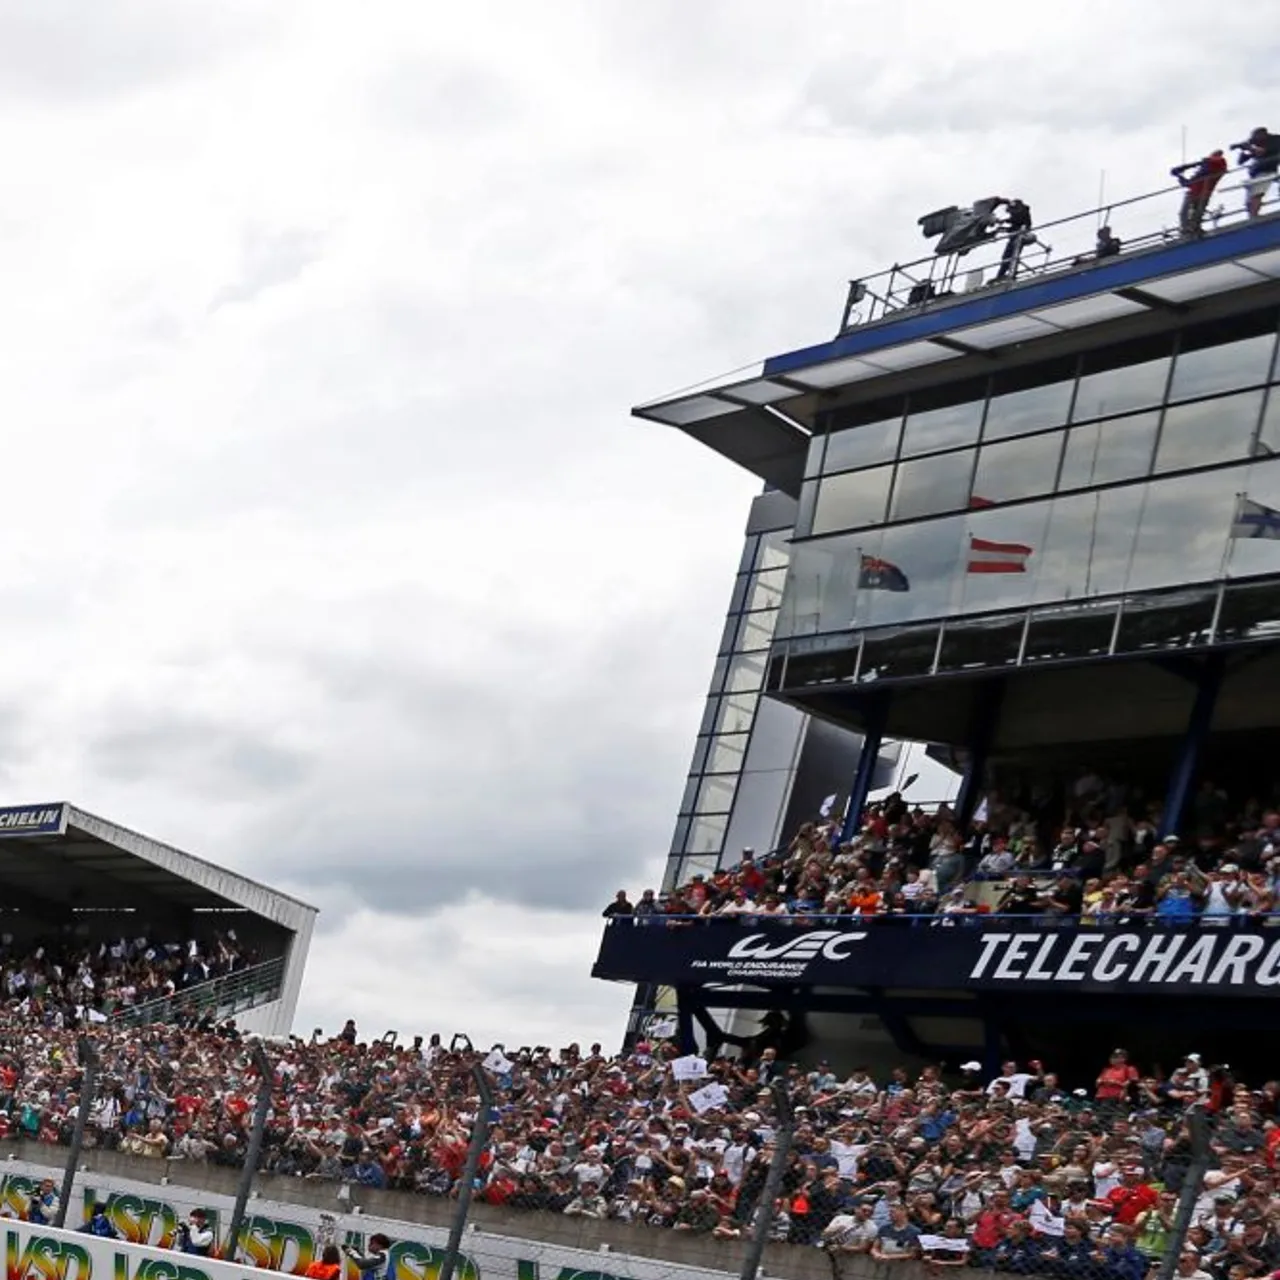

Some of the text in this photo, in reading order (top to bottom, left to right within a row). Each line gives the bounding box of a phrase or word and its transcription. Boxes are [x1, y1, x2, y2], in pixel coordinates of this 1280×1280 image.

[728, 930, 868, 961] WEC
[709, 961, 741, 969] WORLD
[742, 961, 809, 971] ENDURANCE
[204, 1207, 315, 1276] SD
